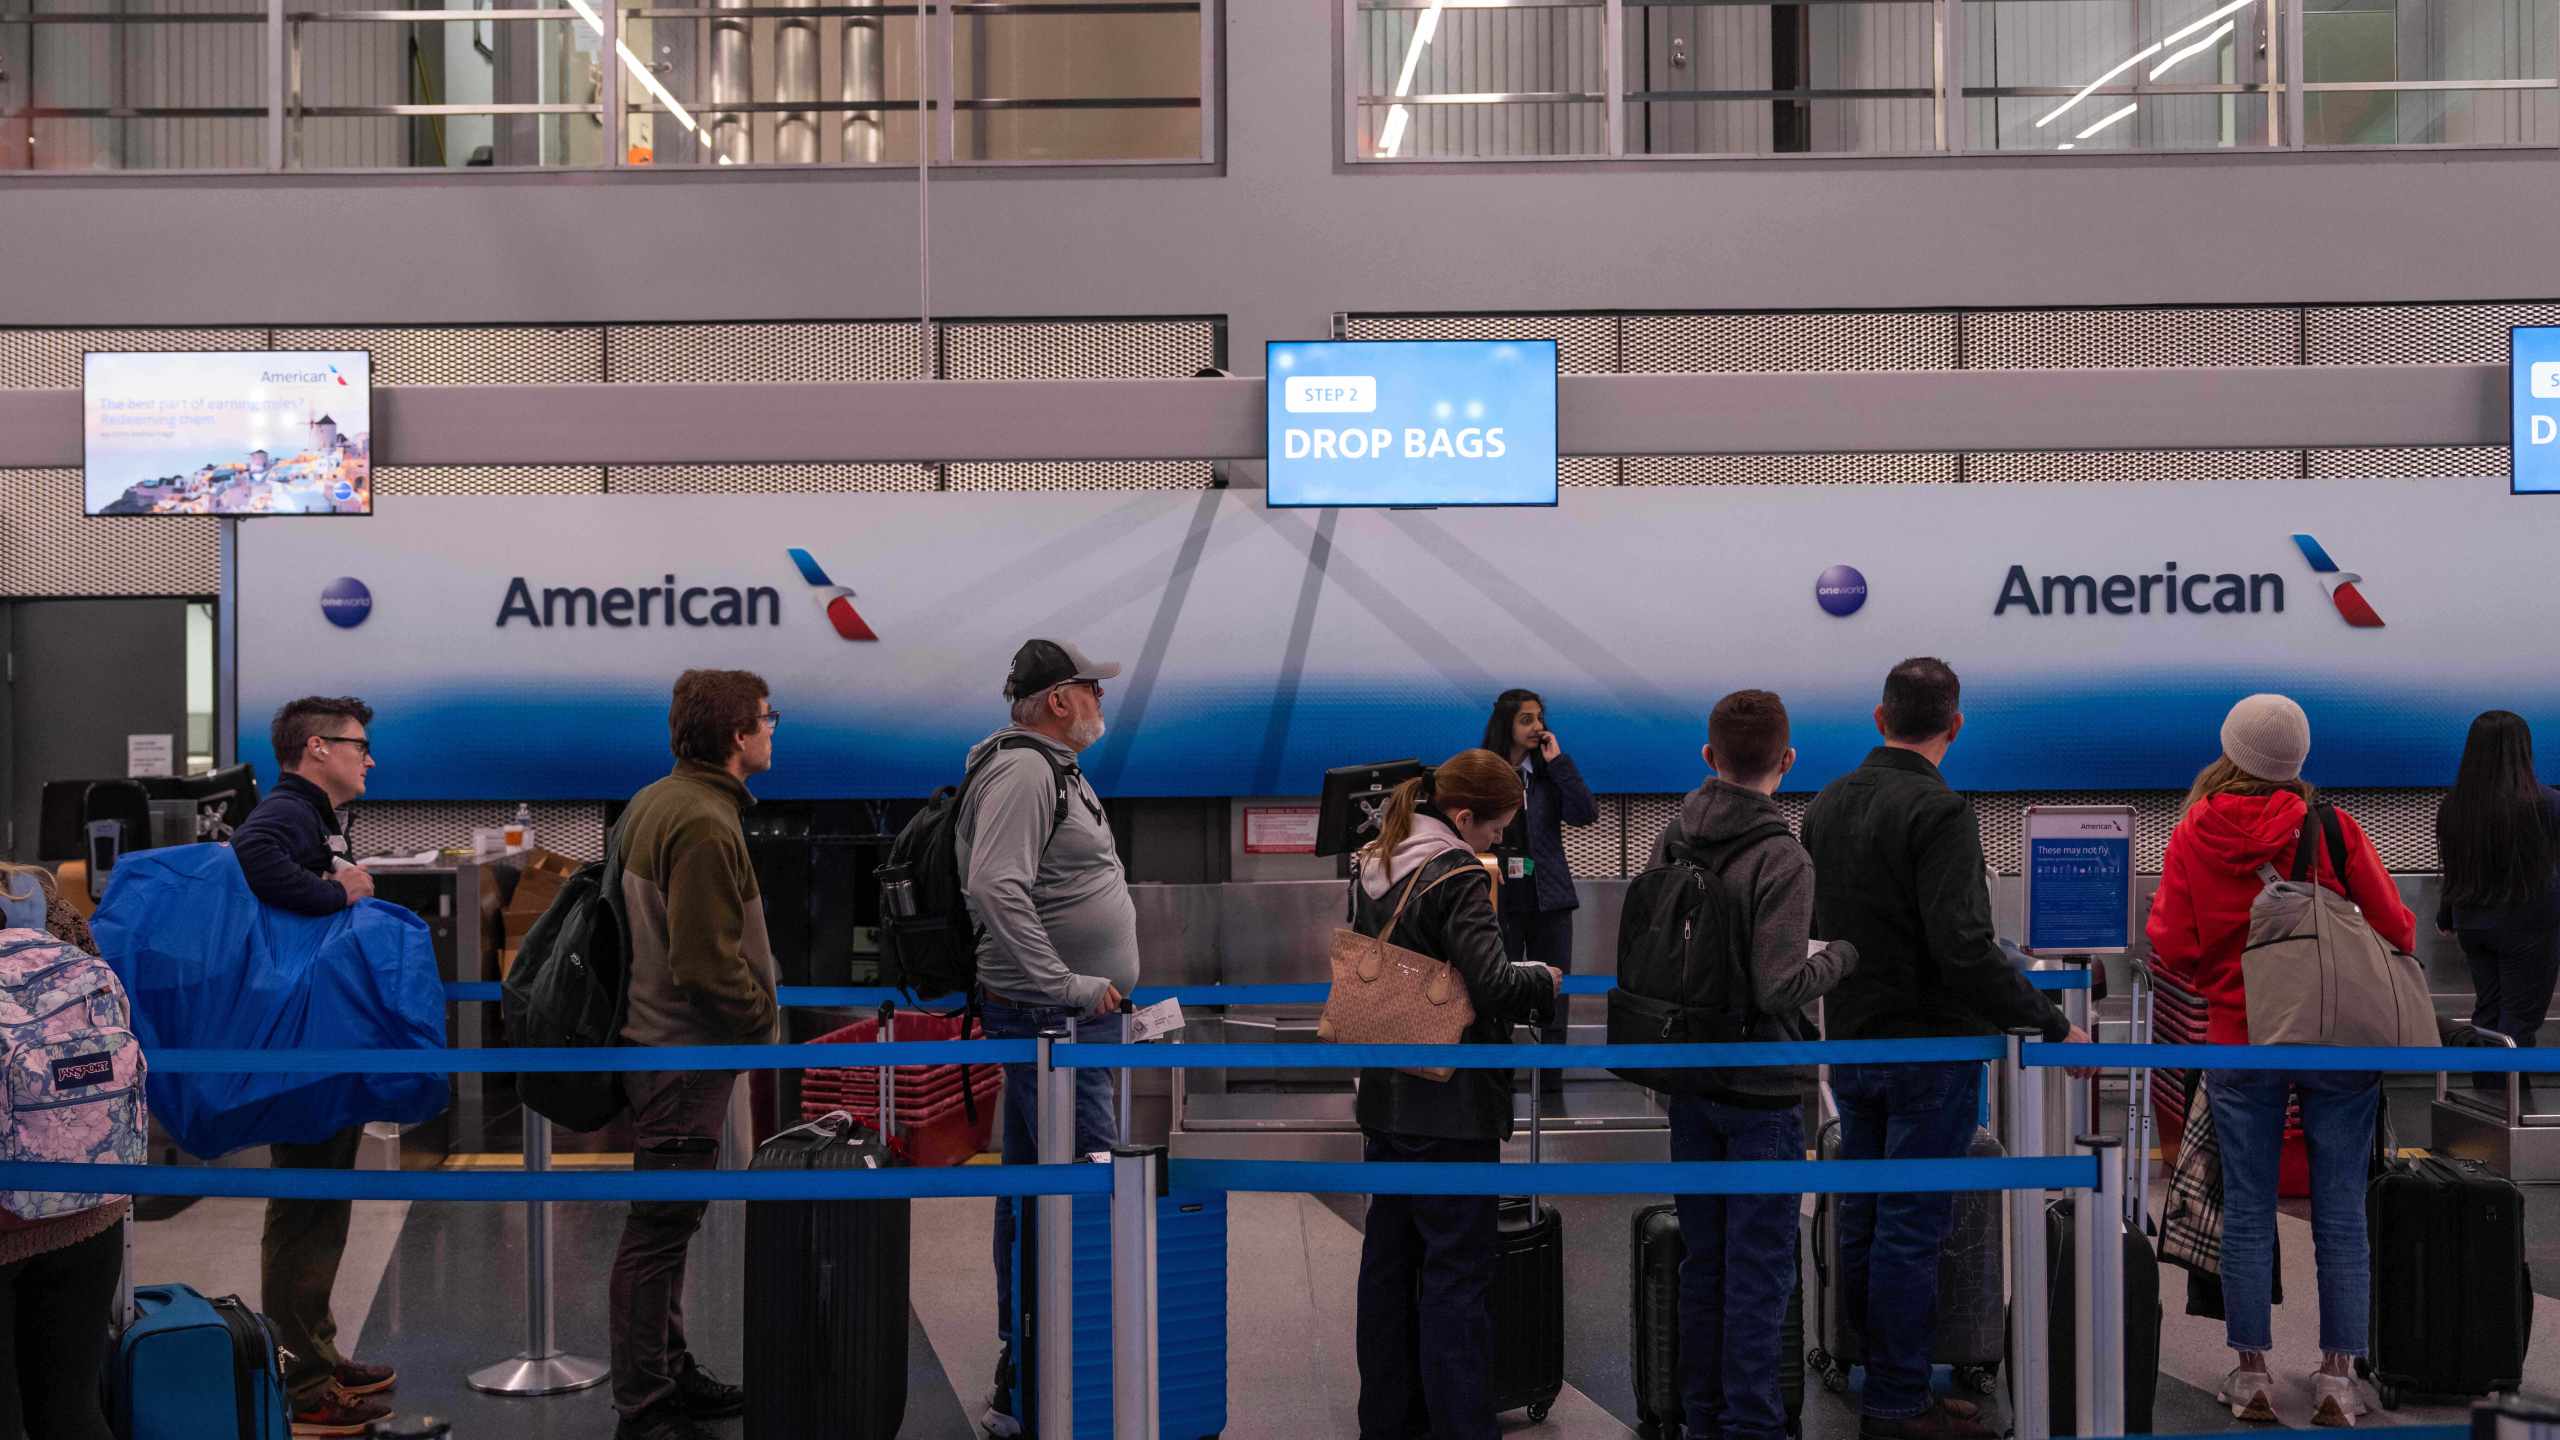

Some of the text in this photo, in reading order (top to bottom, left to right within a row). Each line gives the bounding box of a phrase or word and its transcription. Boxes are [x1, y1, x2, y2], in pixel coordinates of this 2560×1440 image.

[260, 370, 327, 383] American
[1304, 387, 1358, 402] STEP 2
[100, 398, 124, 410] The
[128, 398, 155, 410] best
[159, 399, 187, 412] part
[191, 398, 205, 410] of
[207, 399, 256, 412] earning
[100, 415, 176, 428] Redeeming
[1284, 426, 1506, 460] DROP BAGS
[1818, 585, 1865, 595] oneworld
[1993, 561, 2284, 616] American
[321, 597, 370, 607] oneworld
[496, 574, 780, 628] American
[2080, 823, 2112, 831] American
[2038, 845, 2062, 855] These
[2063, 847, 2081, 857] may
[2082, 846, 2097, 855] not
[57, 1060, 109, 1082] JANSPORT
